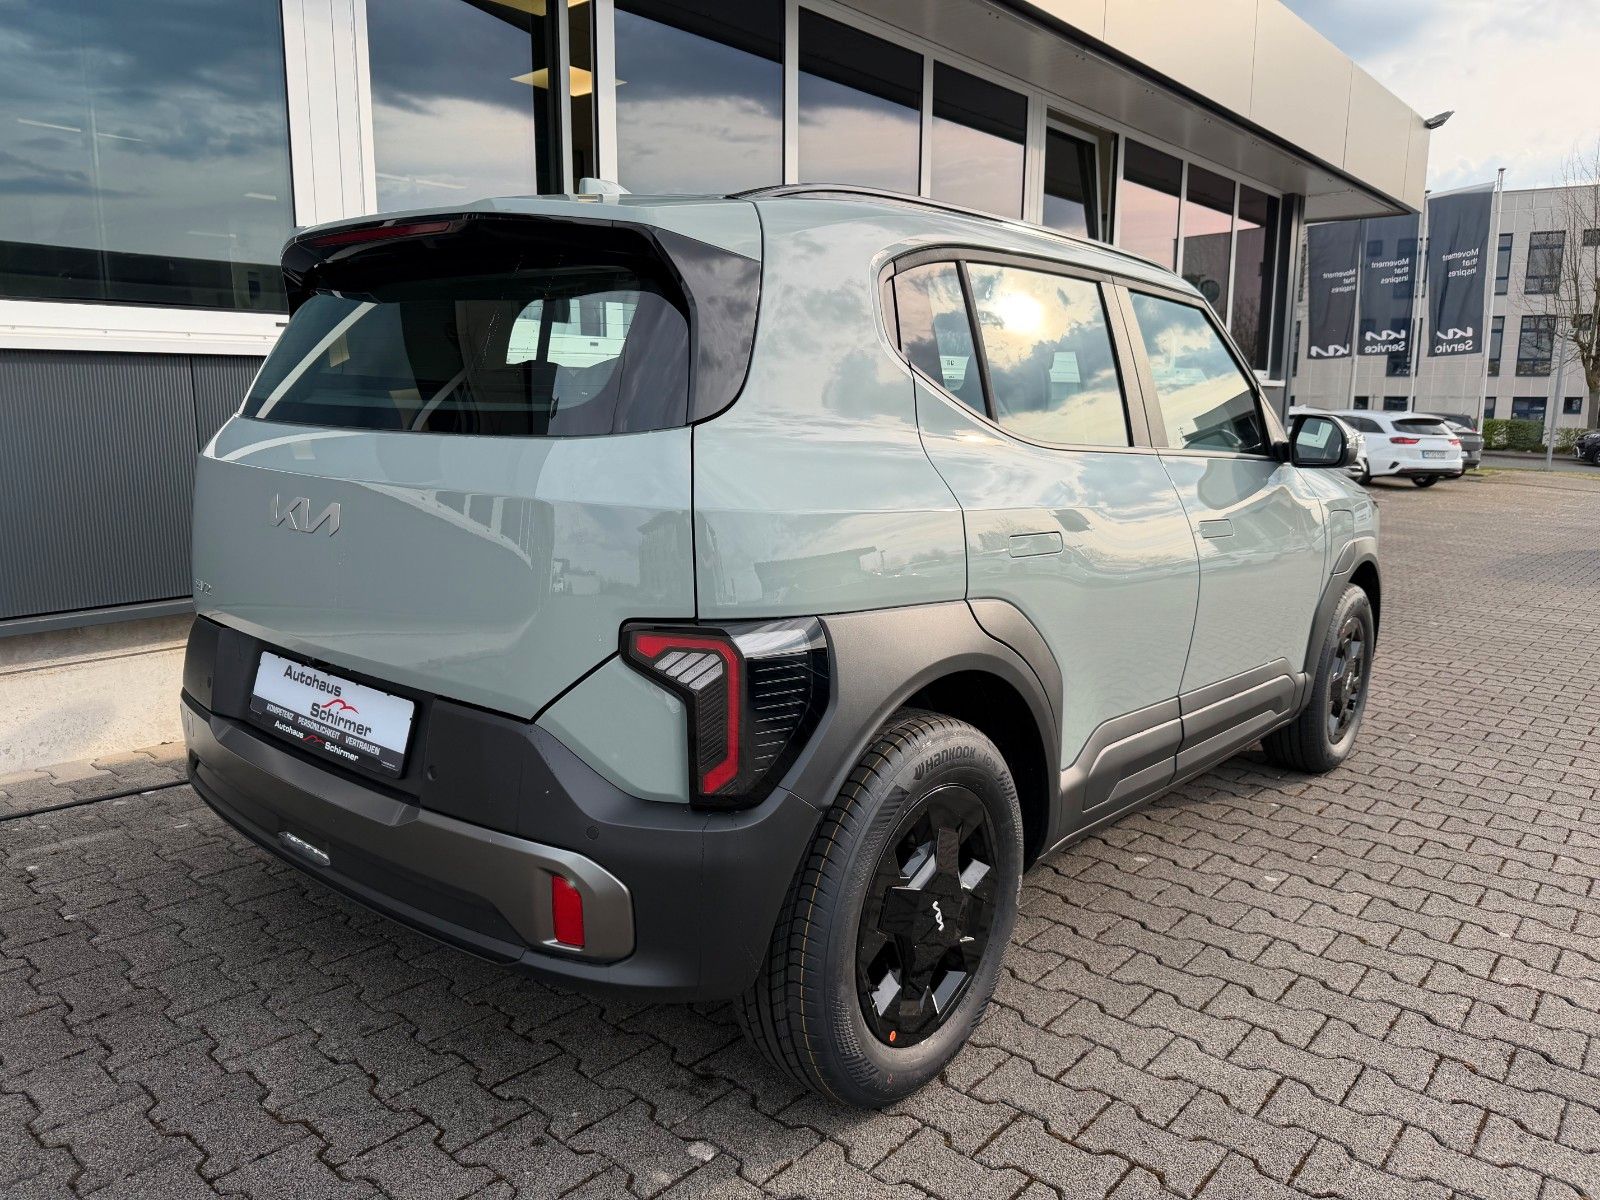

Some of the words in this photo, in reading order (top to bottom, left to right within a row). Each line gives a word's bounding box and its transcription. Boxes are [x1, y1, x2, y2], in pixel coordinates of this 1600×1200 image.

[270, 493, 342, 537] KIA
[283, 664, 342, 697] Autohaus
[266, 703, 295, 722] KOMPETENZ
[345, 735, 381, 756] VERTRAUEN
[274, 719, 304, 740] Autohaus
[324, 741, 360, 762] Schirmer
[309, 702, 372, 738] Schirmer
